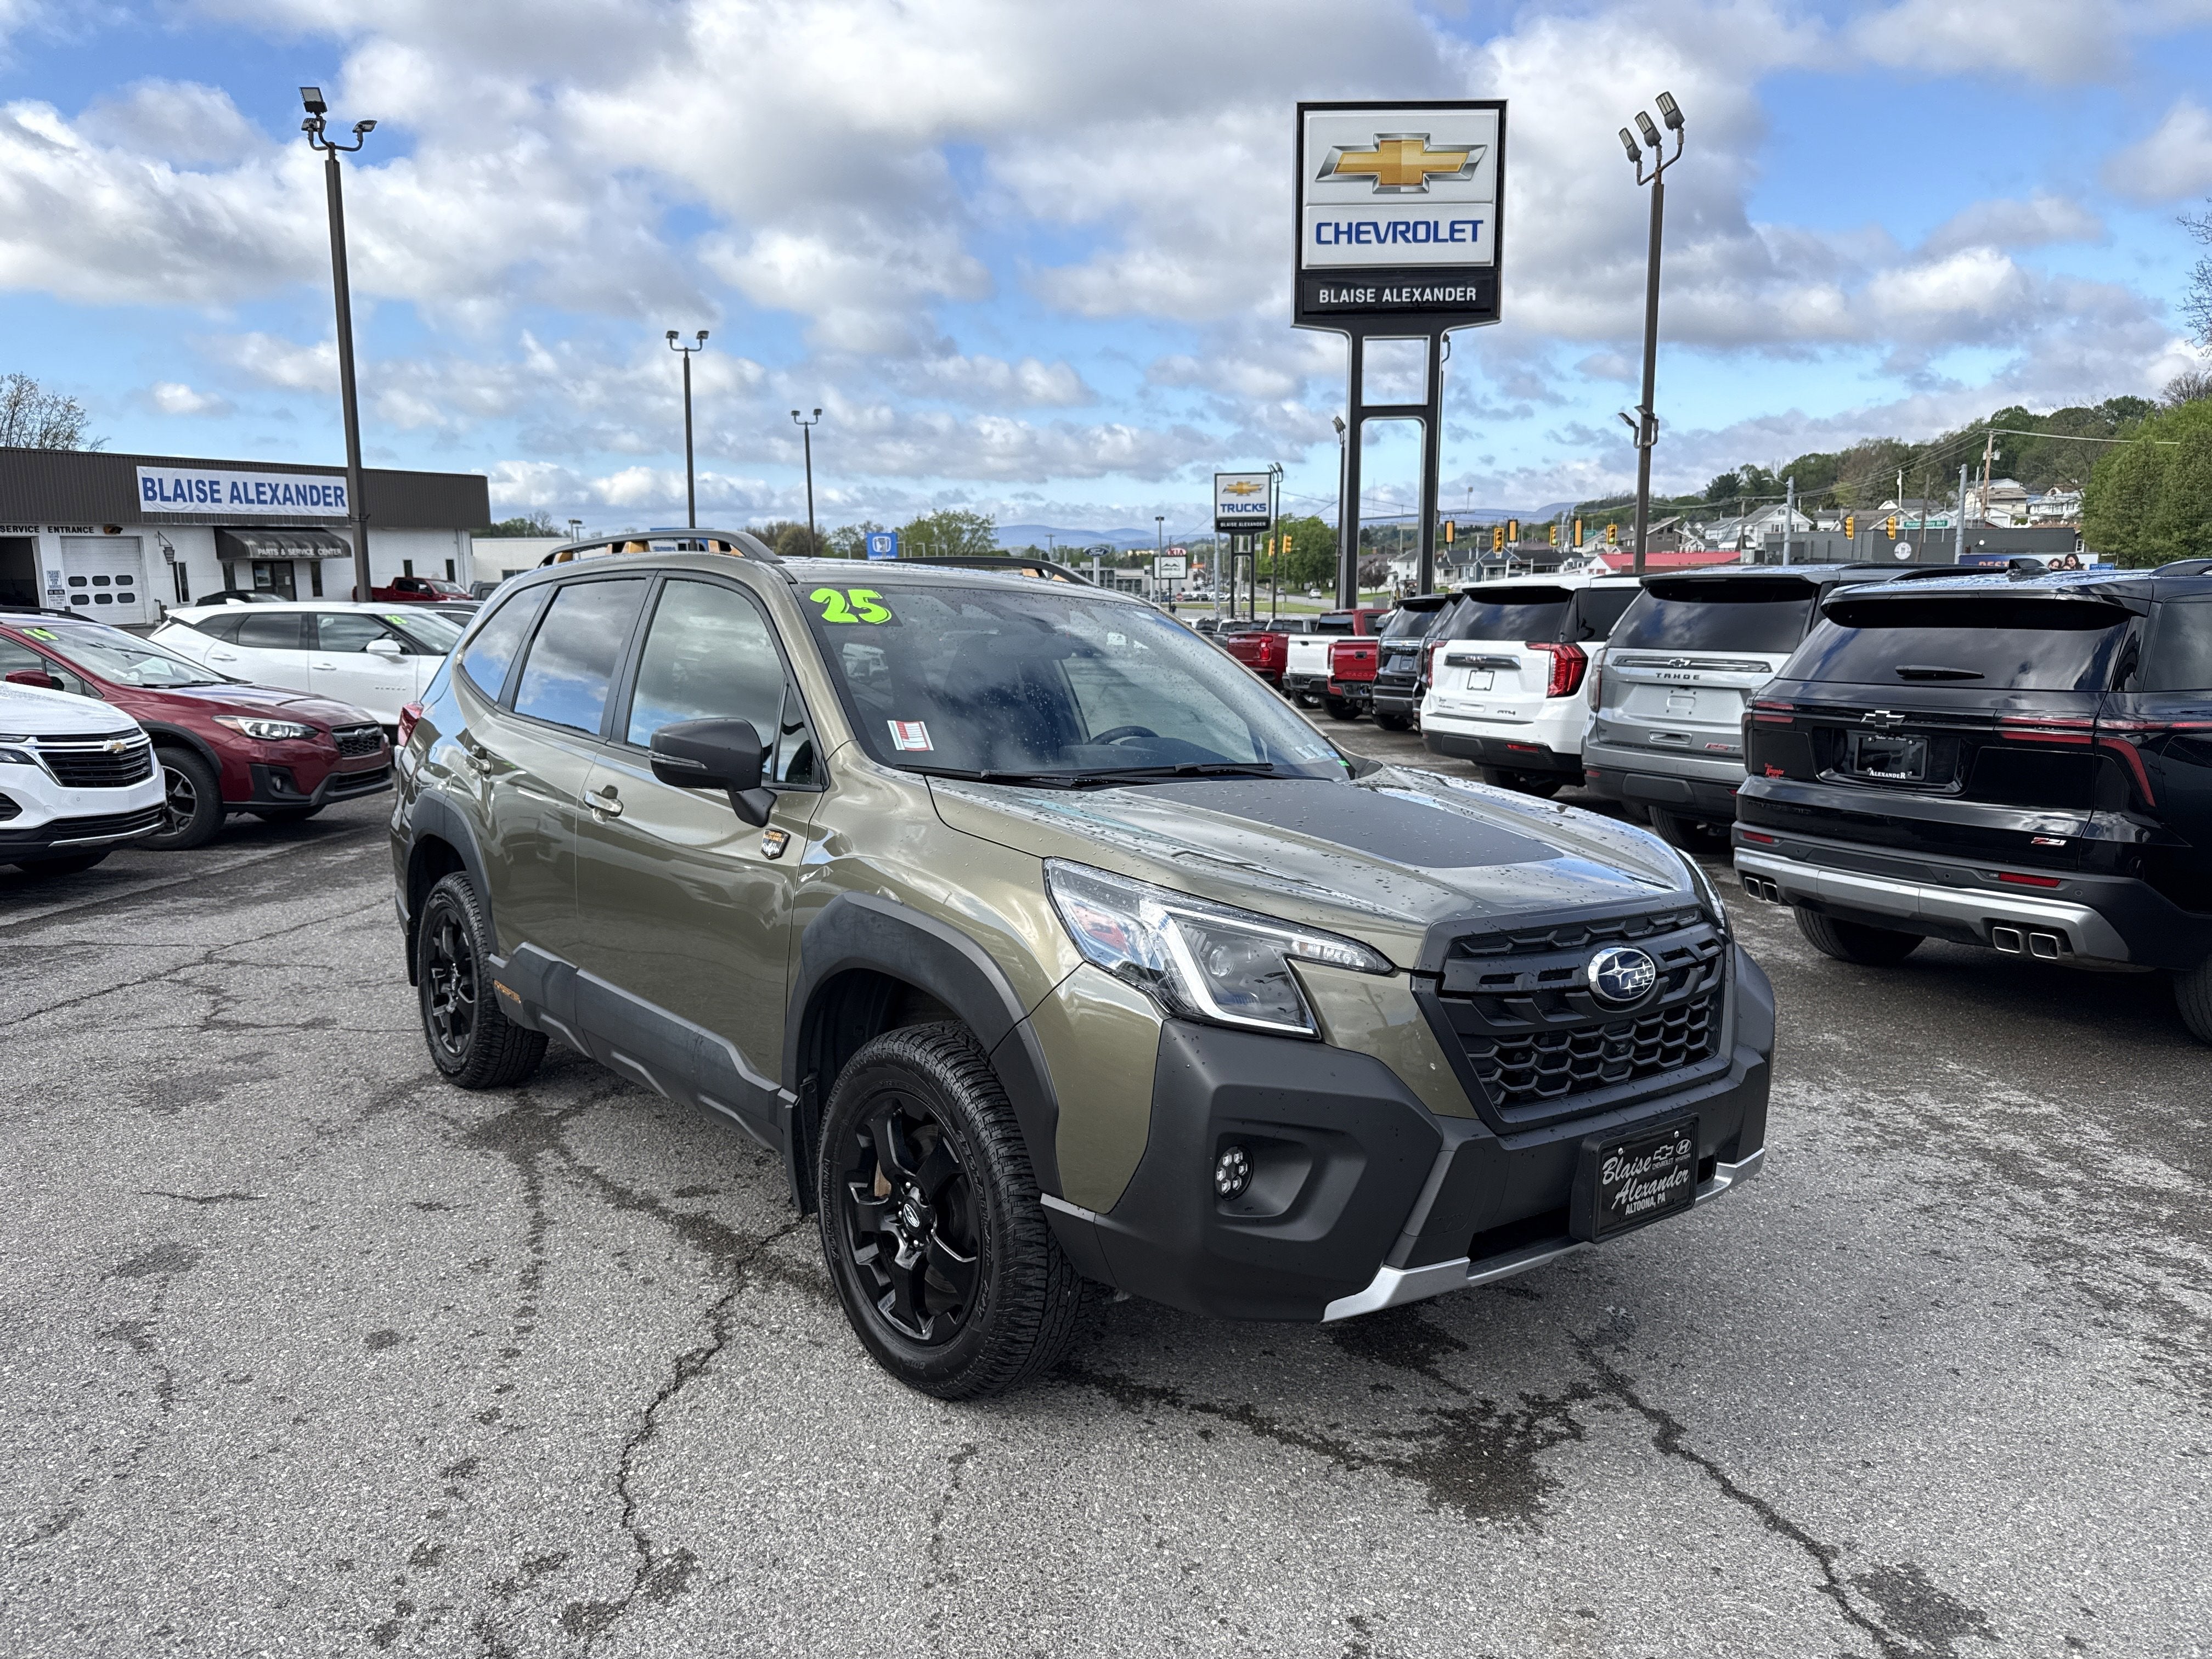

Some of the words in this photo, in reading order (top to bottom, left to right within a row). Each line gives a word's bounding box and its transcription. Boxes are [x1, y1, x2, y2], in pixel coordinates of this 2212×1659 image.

[1316, 219, 1484, 245] CHEVROLET
[1319, 288, 1376, 303] BLAISE
[1382, 287, 1477, 303] ALEXANDER
[142, 477, 223, 504] BLAISE
[229, 481, 347, 507] ALEXANDER
[1220, 503, 1267, 513] TRUCKS
[0, 525, 40, 533] SERVICE
[48, 526, 94, 534] ENTRANCE
[257, 548, 279, 556] PARTS
[280, 548, 286, 556] &
[287, 548, 315, 556] SERVICE
[317, 548, 342, 556] CENTER
[810, 588, 892, 624] 25
[2030, 837, 2067, 847] Z71
[1602, 1156, 1651, 1186] Blaise
[1652, 1157, 1674, 1170] CHEVROLET
[1611, 1164, 1690, 1210] Alexander
[1625, 1195, 1656, 1216] ALTOONA,
[1657, 1192, 1666, 1205] PA
